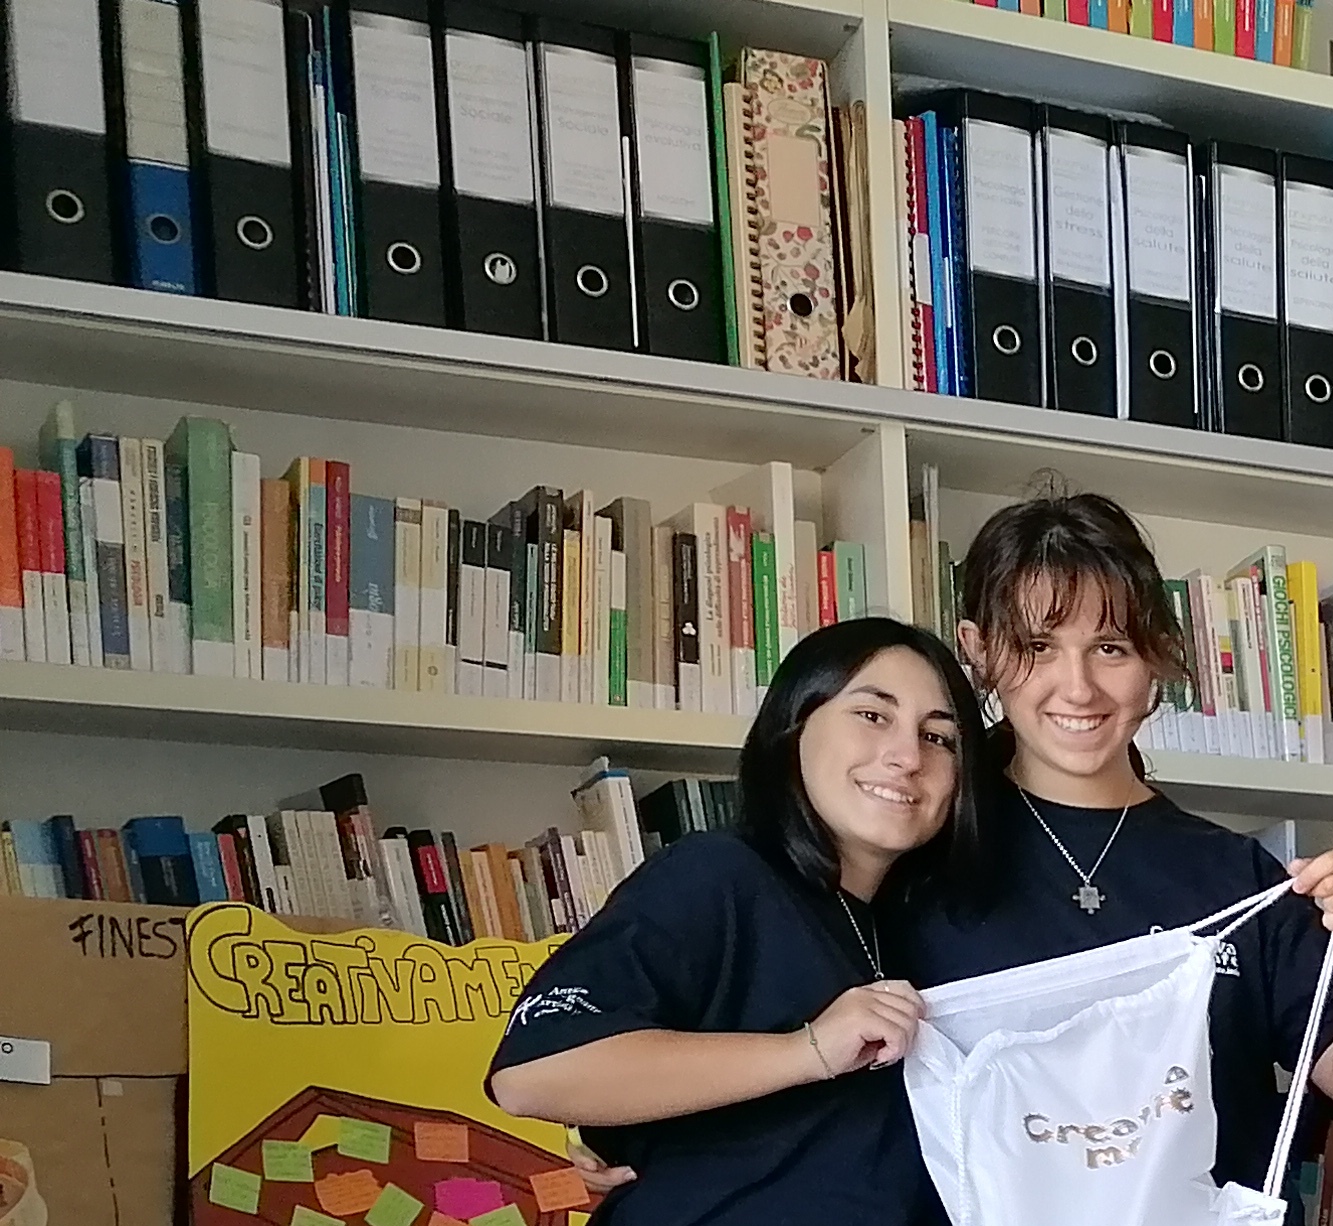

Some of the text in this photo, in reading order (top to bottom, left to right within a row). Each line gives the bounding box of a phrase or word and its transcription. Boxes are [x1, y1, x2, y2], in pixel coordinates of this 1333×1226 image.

[1272, 575, 1296, 720] GIOCHI PSICOLOGICI
[68, 913, 188, 959] FINEST
